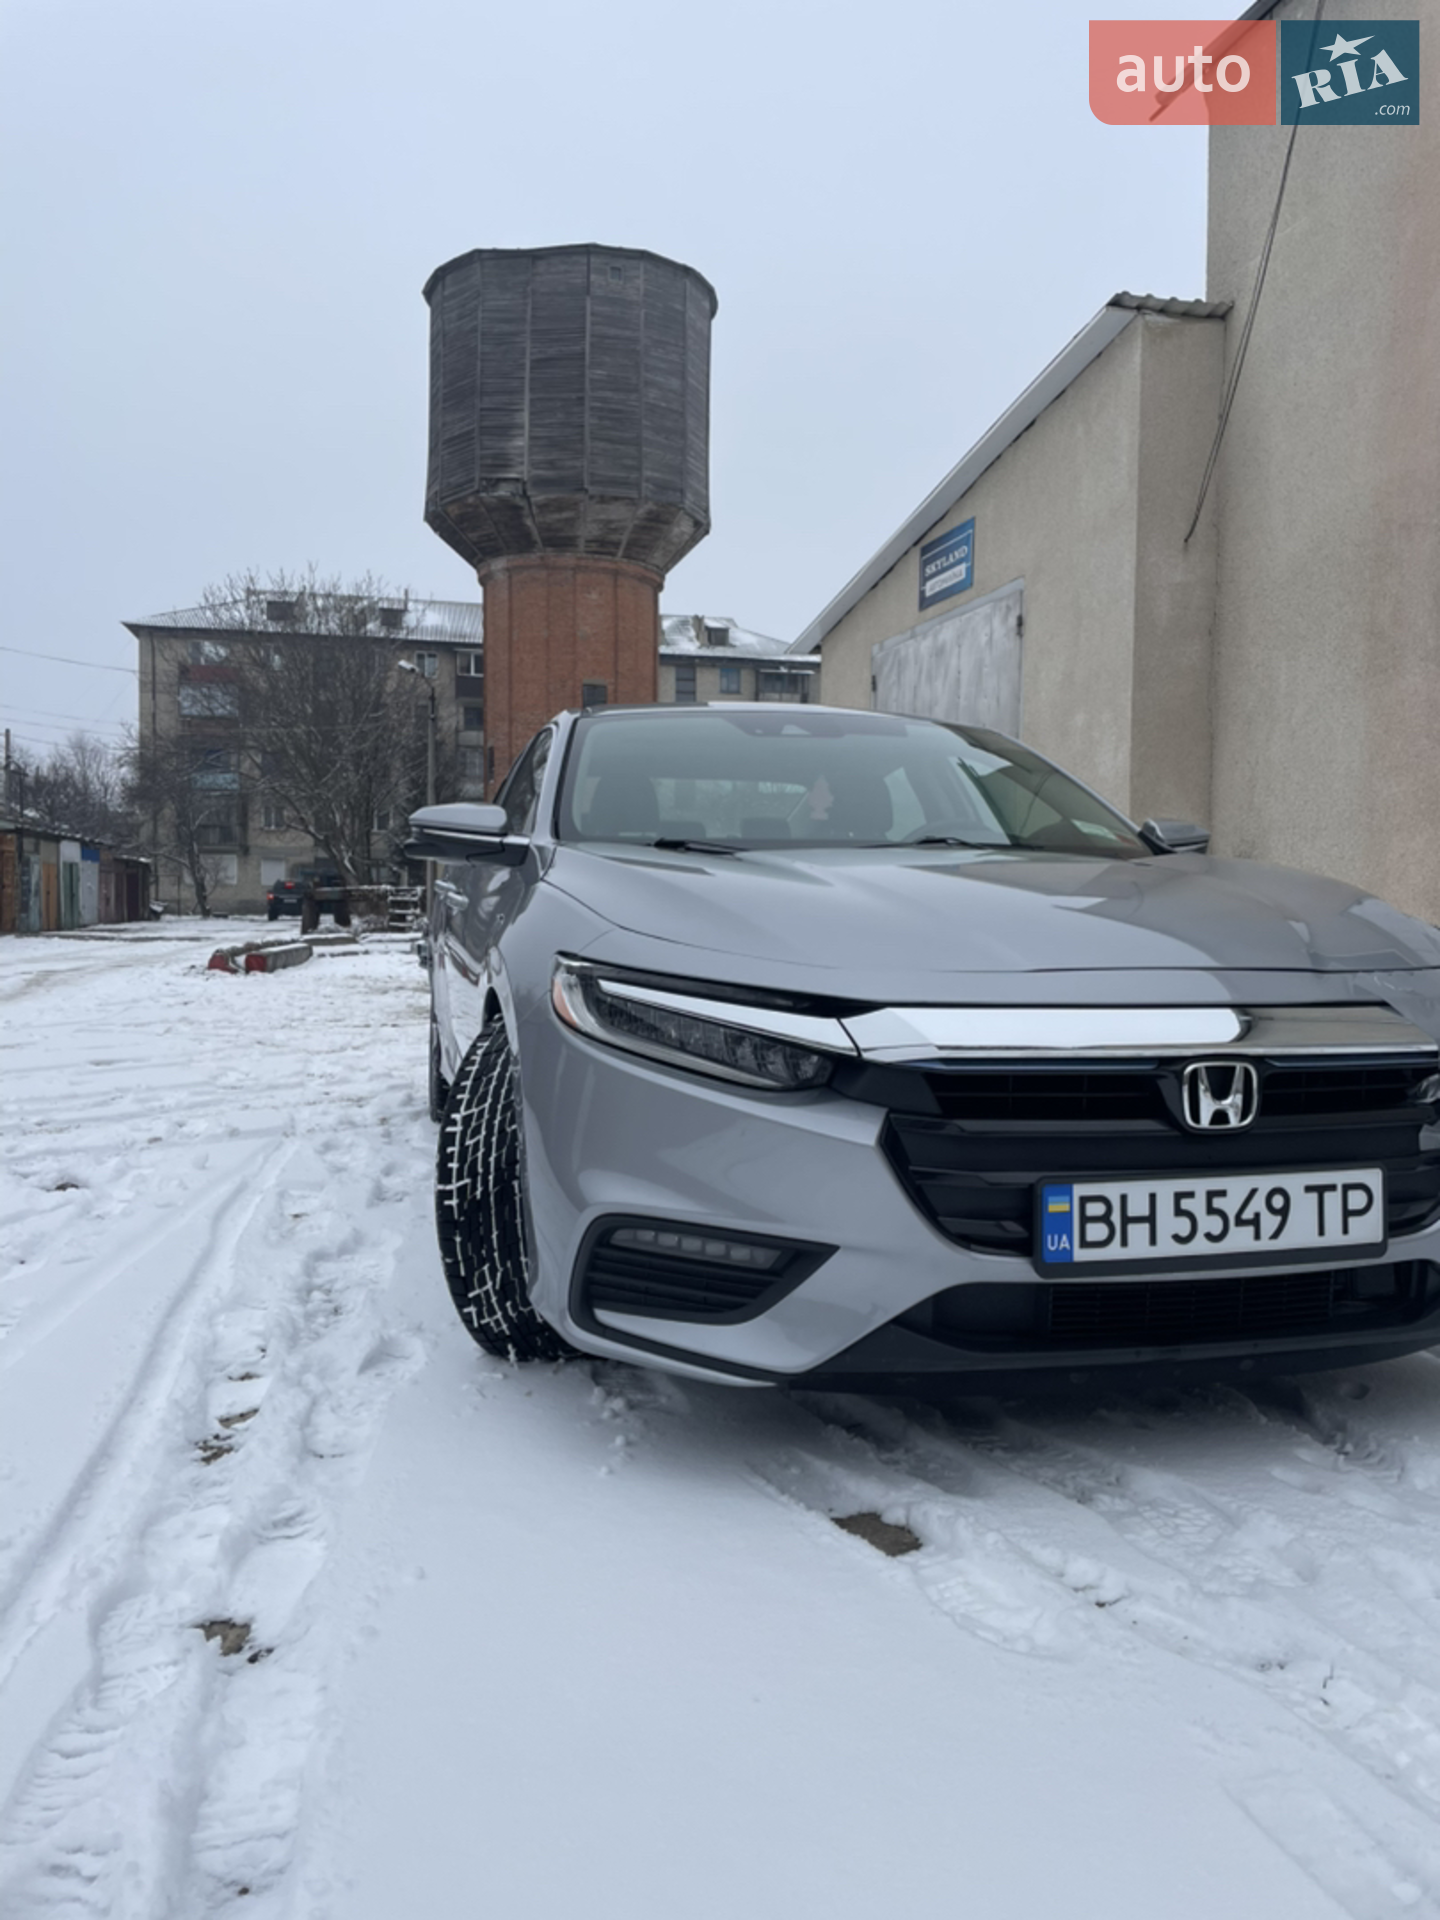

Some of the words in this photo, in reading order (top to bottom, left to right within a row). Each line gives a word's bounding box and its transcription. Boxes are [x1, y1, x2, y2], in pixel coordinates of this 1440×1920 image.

[925, 545, 968, 577] SKYLAND
[1078, 1192, 1158, 1249] BH
[1170, 1187, 1292, 1246] 5549
[1304, 1181, 1375, 1237] TP
[1047, 1234, 1070, 1251] UA
